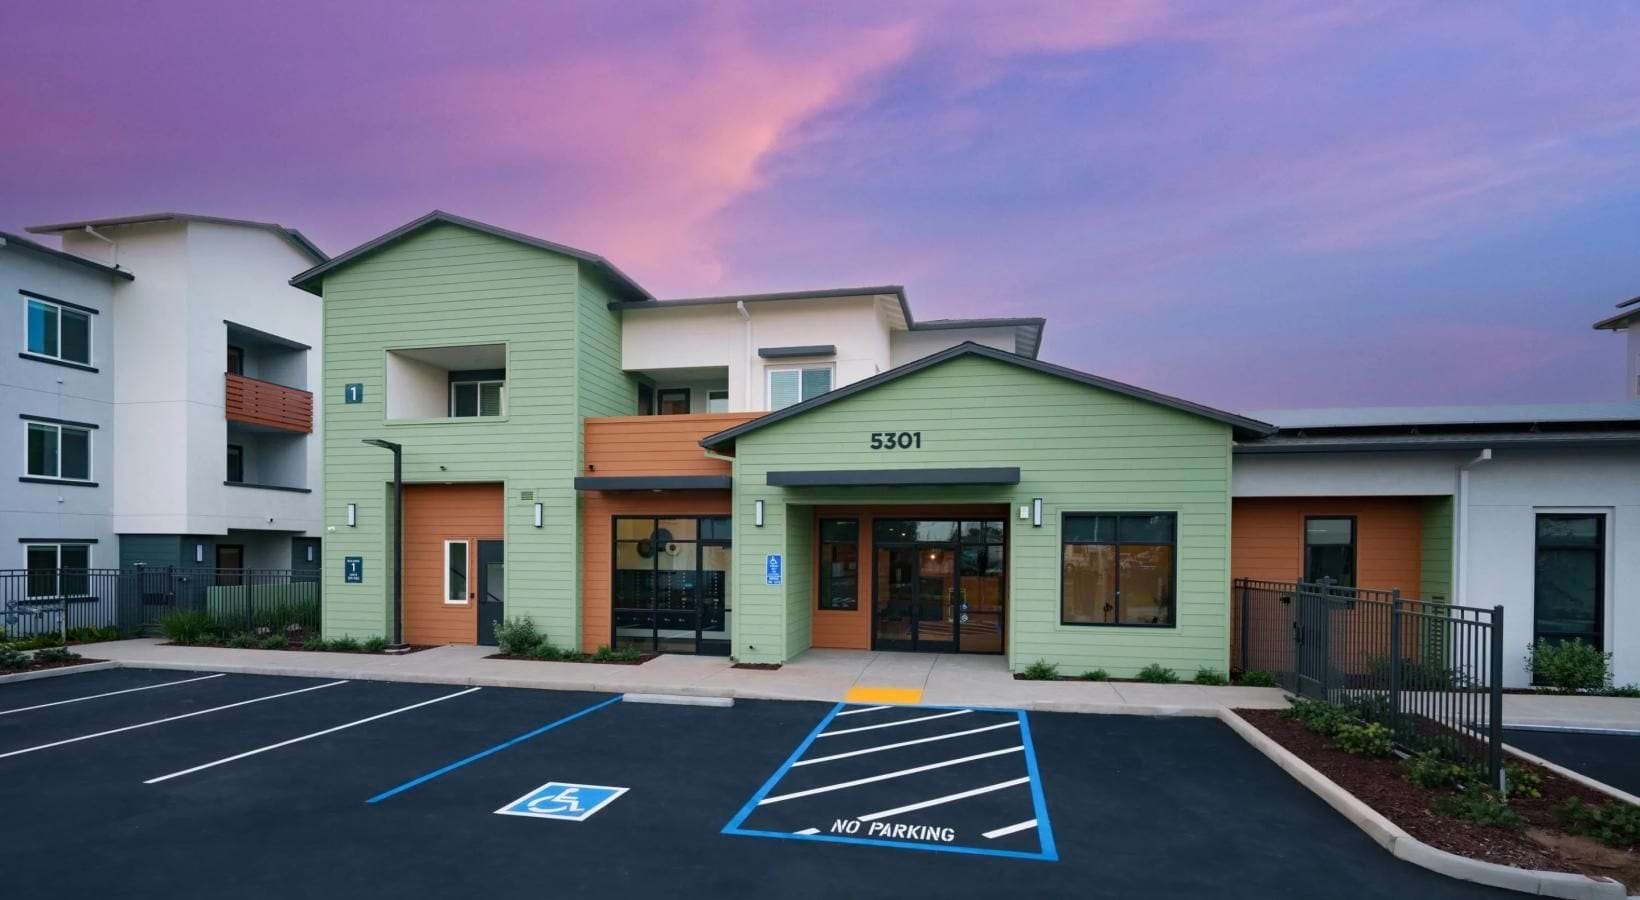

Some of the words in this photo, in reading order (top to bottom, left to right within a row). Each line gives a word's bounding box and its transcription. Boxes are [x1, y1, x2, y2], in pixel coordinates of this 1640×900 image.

[350, 386, 356, 401] 1
[870, 431, 921, 450] 5301
[830, 819, 861, 834] NO
[868, 822, 955, 842] PARKING
